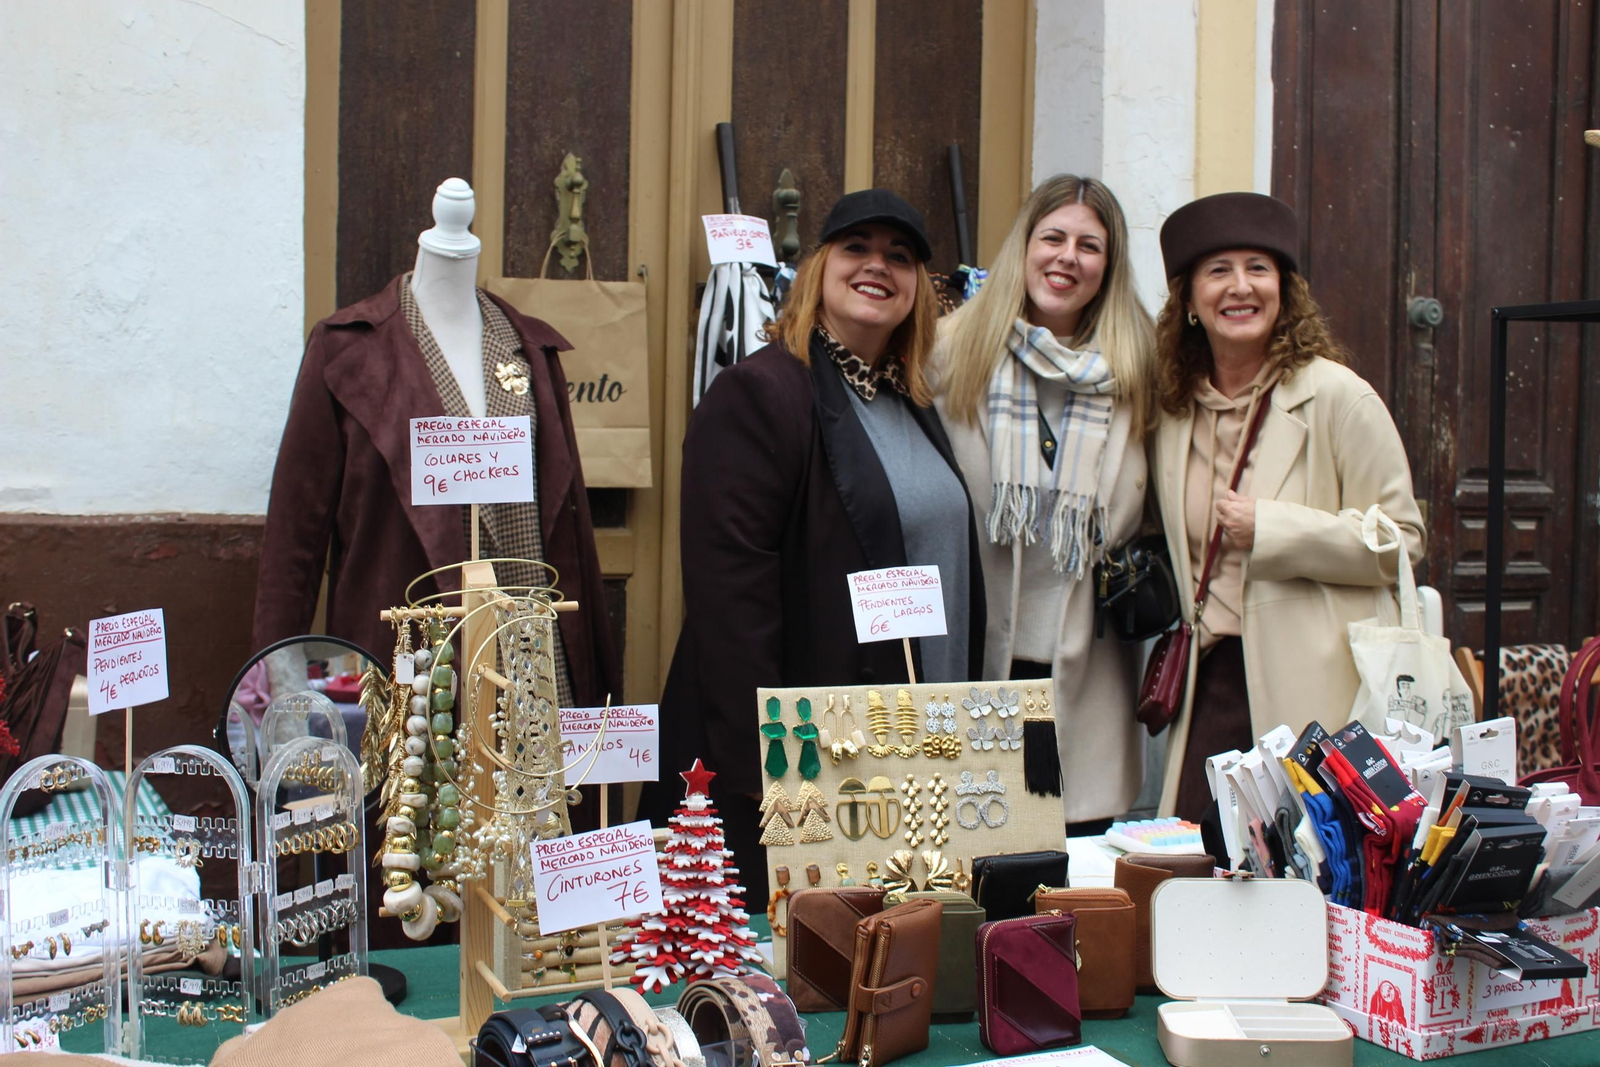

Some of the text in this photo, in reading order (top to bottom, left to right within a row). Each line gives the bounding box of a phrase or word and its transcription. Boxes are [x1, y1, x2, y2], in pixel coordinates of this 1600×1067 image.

[735, 238, 754, 251] 3€
[566, 373, 628, 403] ento
[415, 419, 507, 432] PRECIO ESPECIAL
[417, 428, 526, 444] MERCADO NAVIDEÑO
[424, 451, 499, 466] COLLARES Y
[423, 465, 519, 496] 9€ CHOCKERS
[853, 568, 928, 586] PRECIO ESPECIAL
[857, 582, 898, 593] MERCADO
[857, 596, 914, 612] PENDIENTES
[95, 613, 156, 635] PRECIO ESPECIAL
[870, 604, 934, 636] 6€ LARGOS
[94, 631, 131, 649] MERCADO
[93, 650, 142, 676] PENDIENTES
[99, 664, 160, 704] 4€ PEQUEÑOS
[559, 707, 643, 723] PRECIO ESPECIAL
[608, 719, 655, 729] NAVIDEÑO
[629, 747, 652, 768] 4€
[1481, 758, 1500, 771] G&C
[535, 827, 634, 857] PRECIO ESPECIAL
[540, 834, 654, 871] MERCADO NAVIDEÑO
[547, 859, 643, 902] CINTURONES
[606, 880, 649, 911] 7€
[1377, 925, 1421, 943] MERRY CHRISTMAS
[1434, 976, 1453, 988] JAN
[1482, 985, 1492, 998] 3
[1493, 982, 1524, 996] PARES
[1438, 990, 1446, 1010] 1
[1388, 1024, 1406, 1037] JAN
